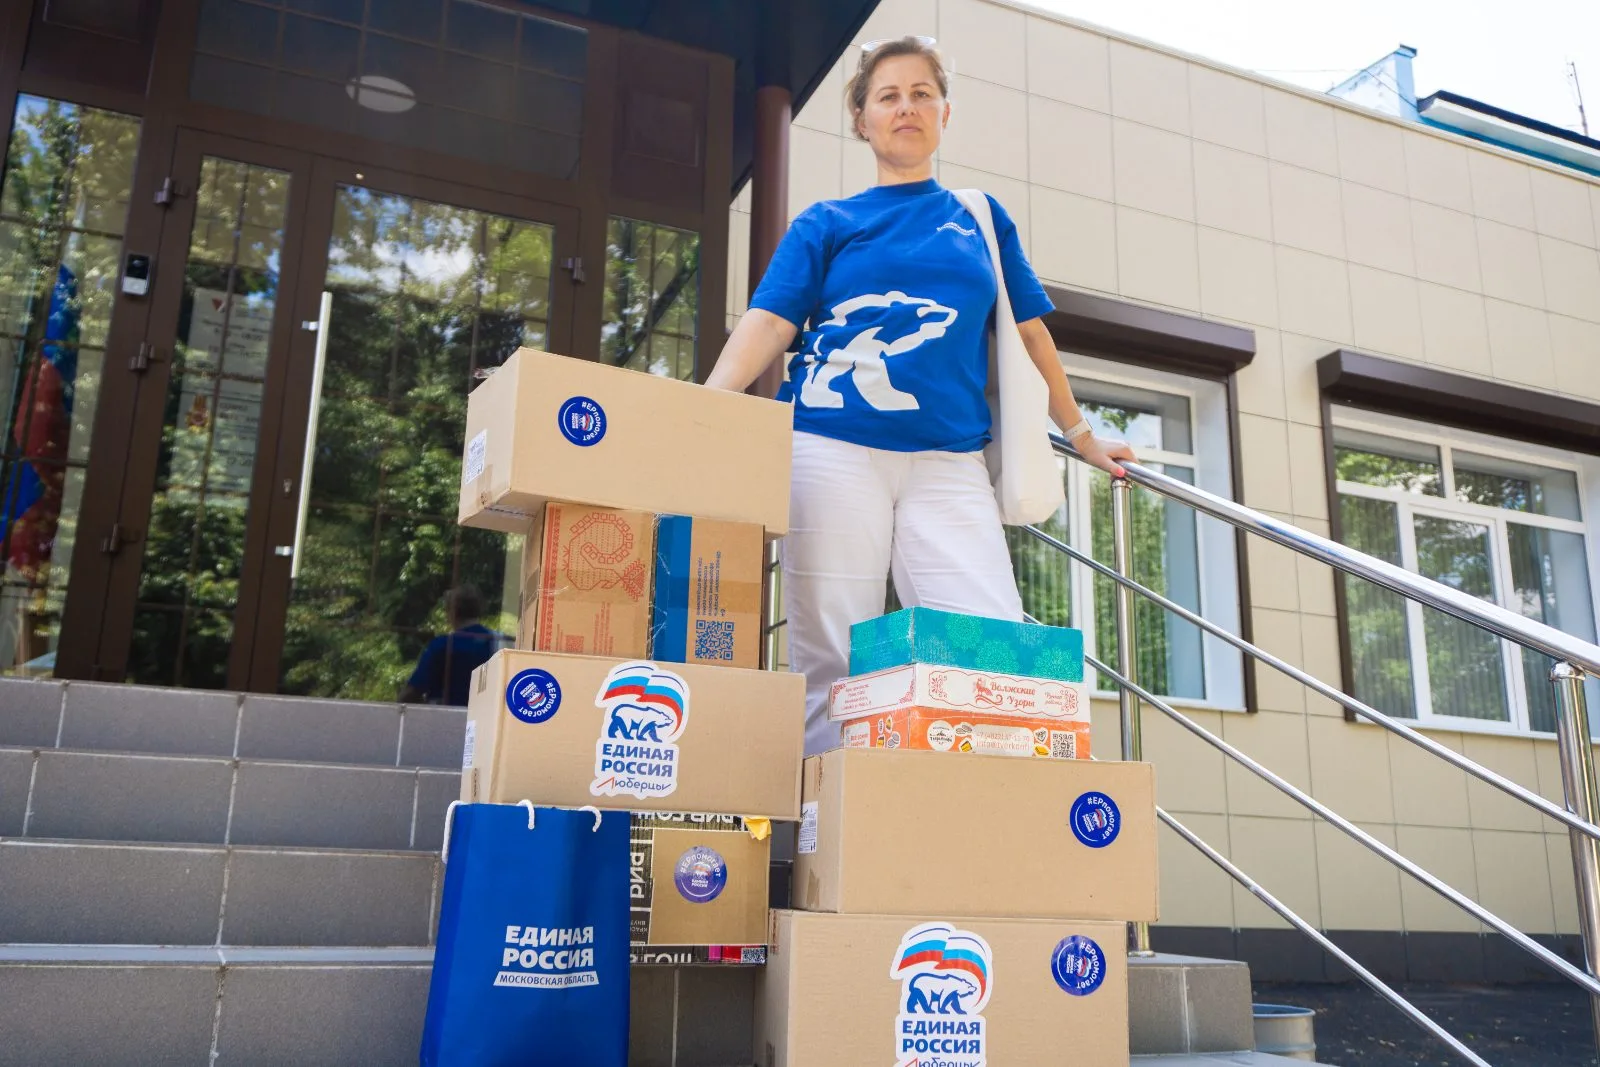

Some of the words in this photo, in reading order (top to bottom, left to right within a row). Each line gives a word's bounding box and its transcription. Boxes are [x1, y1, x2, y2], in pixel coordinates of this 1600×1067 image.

[990, 682, 1036, 696] Волжские
[518, 682, 556, 718] #ЕРпомогает
[1006, 696, 1035, 708] Узоры
[602, 744, 674, 761] ЕДИНАЯ
[601, 759, 673, 777] РОССИЯ
[596, 776, 672, 792] Люберцы
[1087, 796, 1114, 840] #ЕРпомогает
[505, 925, 594, 947] ЕДИНАЯ
[502, 948, 594, 970] РОССИЯ
[1077, 941, 1099, 988] #ЕРпомогает
[500, 975, 563, 986] МОСКОВСКАЯ
[564, 974, 595, 985] ОБЛАСТЬ
[902, 1020, 980, 1036] ЕДИНАЯ
[902, 1038, 980, 1054] РОССИЯ
